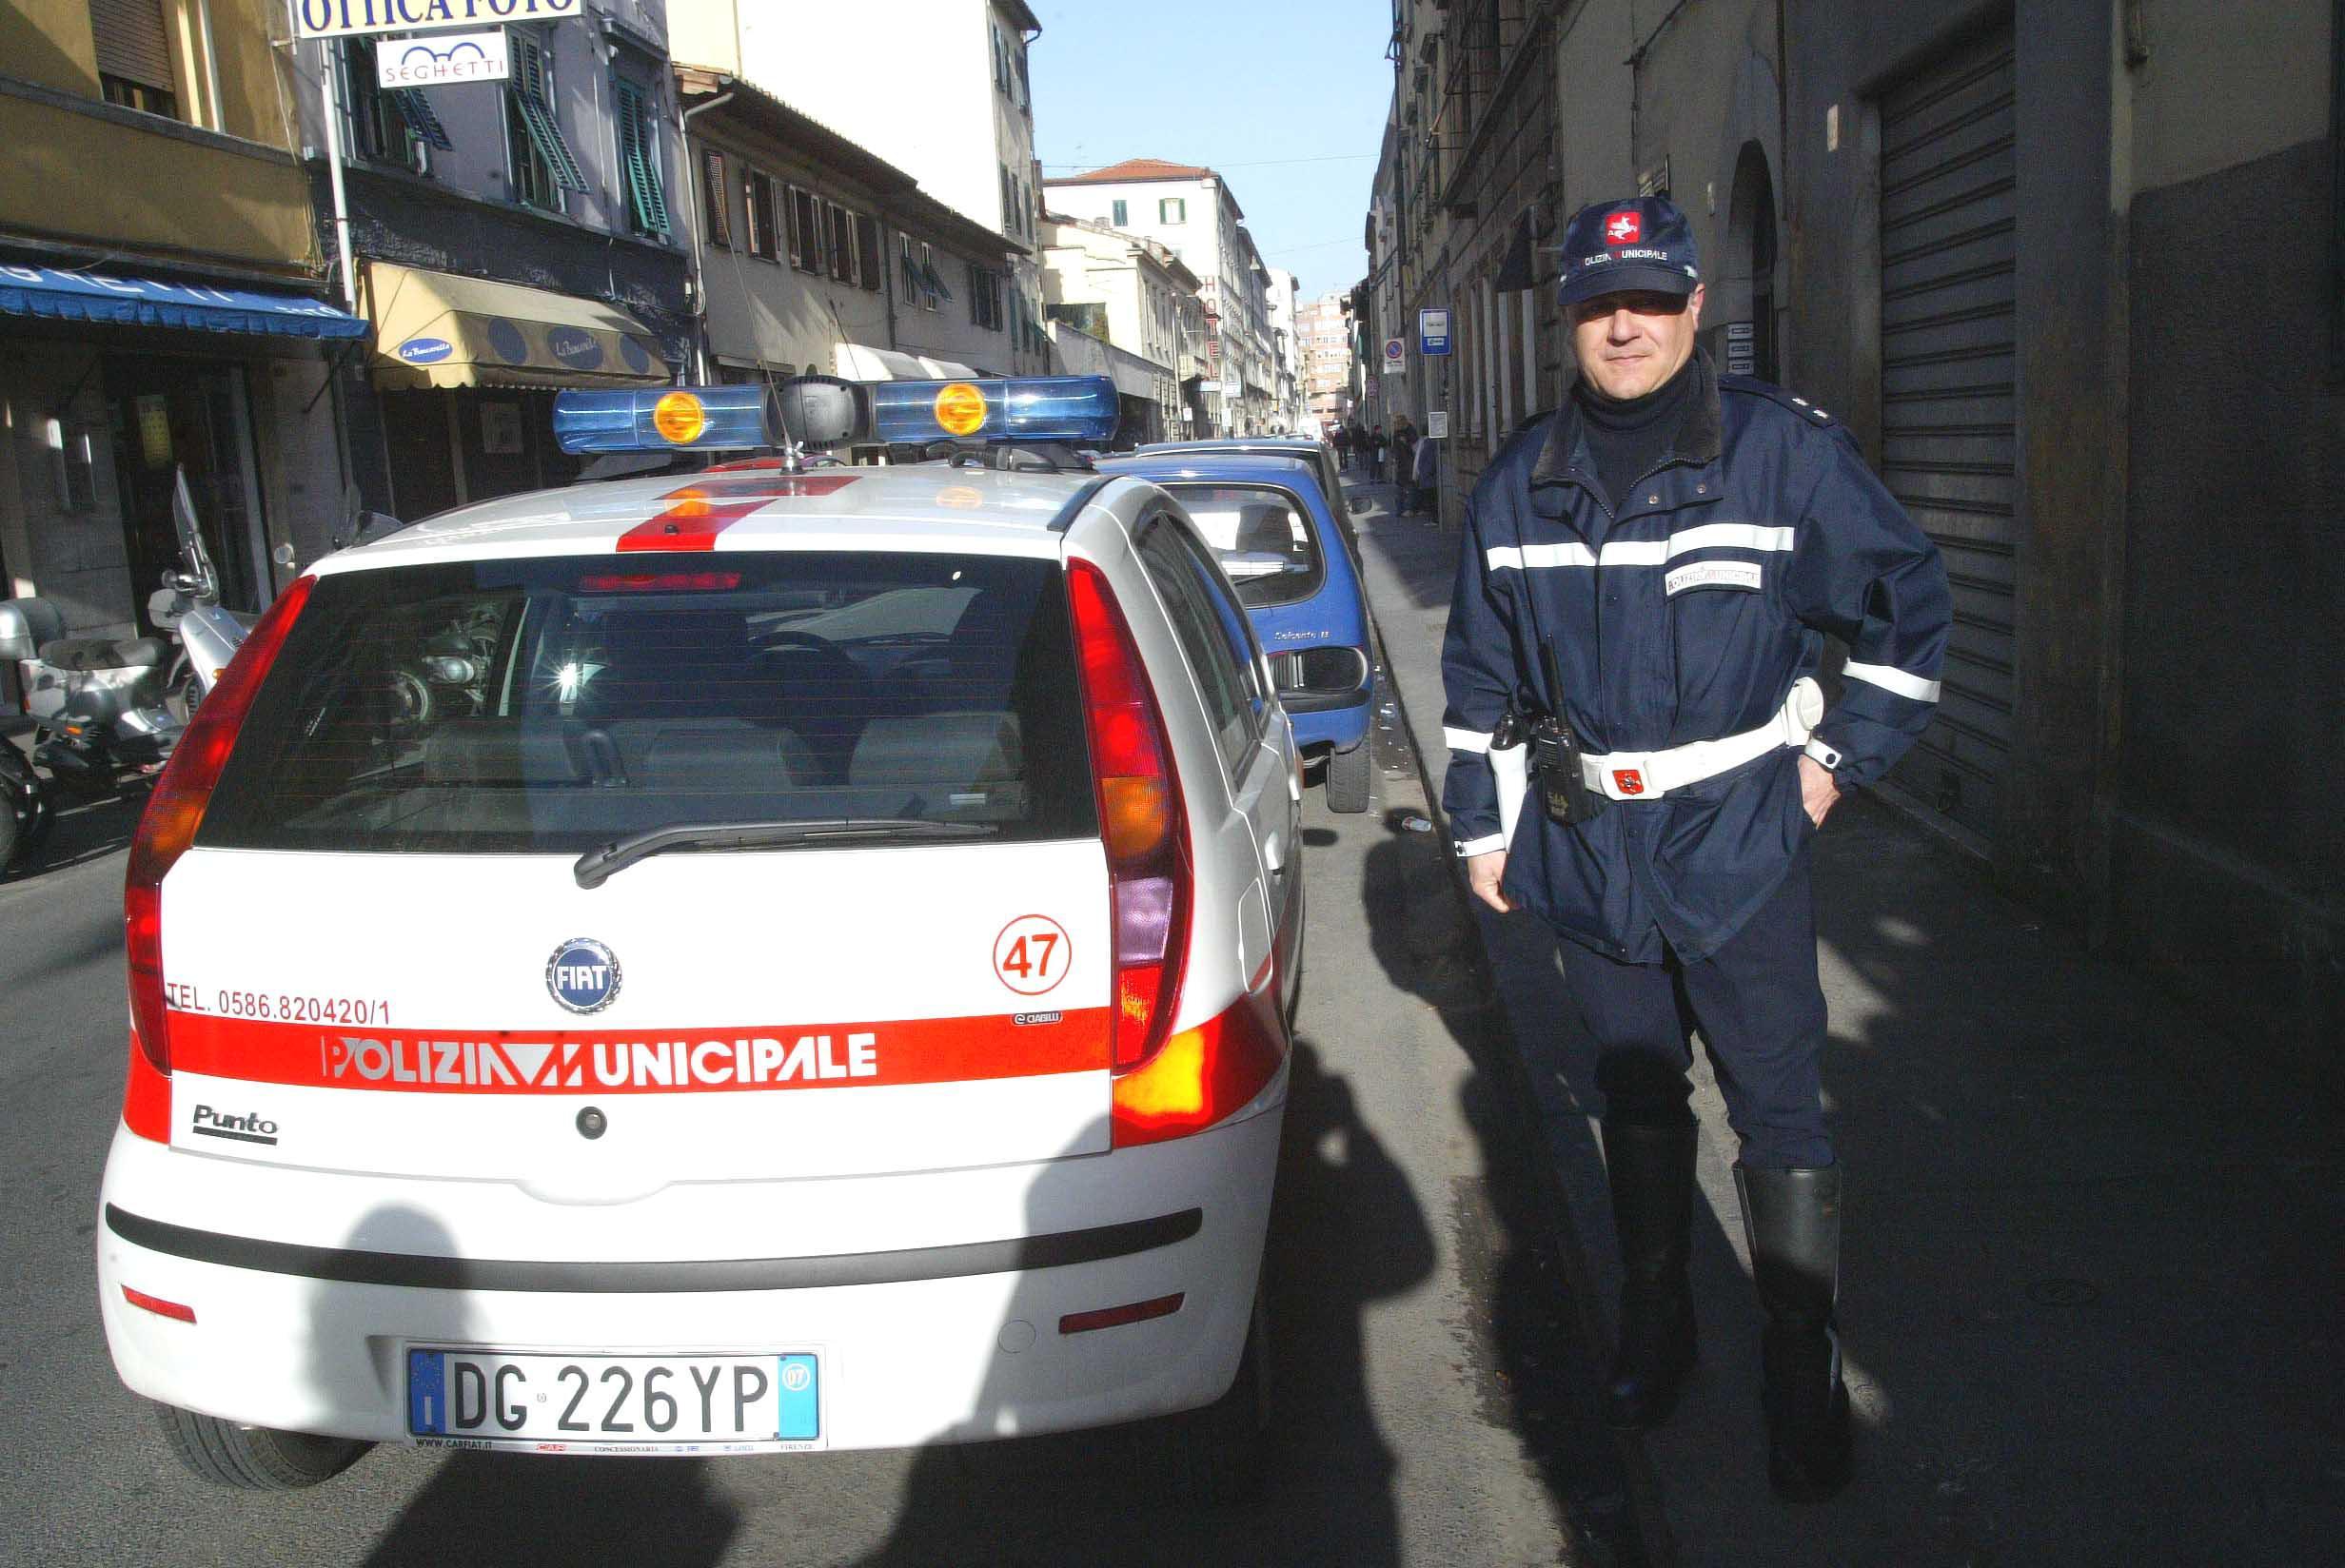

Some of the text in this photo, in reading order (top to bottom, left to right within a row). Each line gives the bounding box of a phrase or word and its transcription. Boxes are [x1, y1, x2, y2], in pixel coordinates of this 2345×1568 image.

[385, 59, 503, 82] SEGHETTI
[1205, 275, 1219, 379] HOTEL
[556, 965, 609, 990] FIAT
[1002, 932, 1059, 978] 47
[166, 982, 390, 1026] TEL. 0586.820420/1
[320, 1033, 520, 1087] POLIZIA
[192, 1104, 279, 1135] Punto
[453, 1362, 528, 1431] DG
[557, 1363, 769, 1434] 226YP
